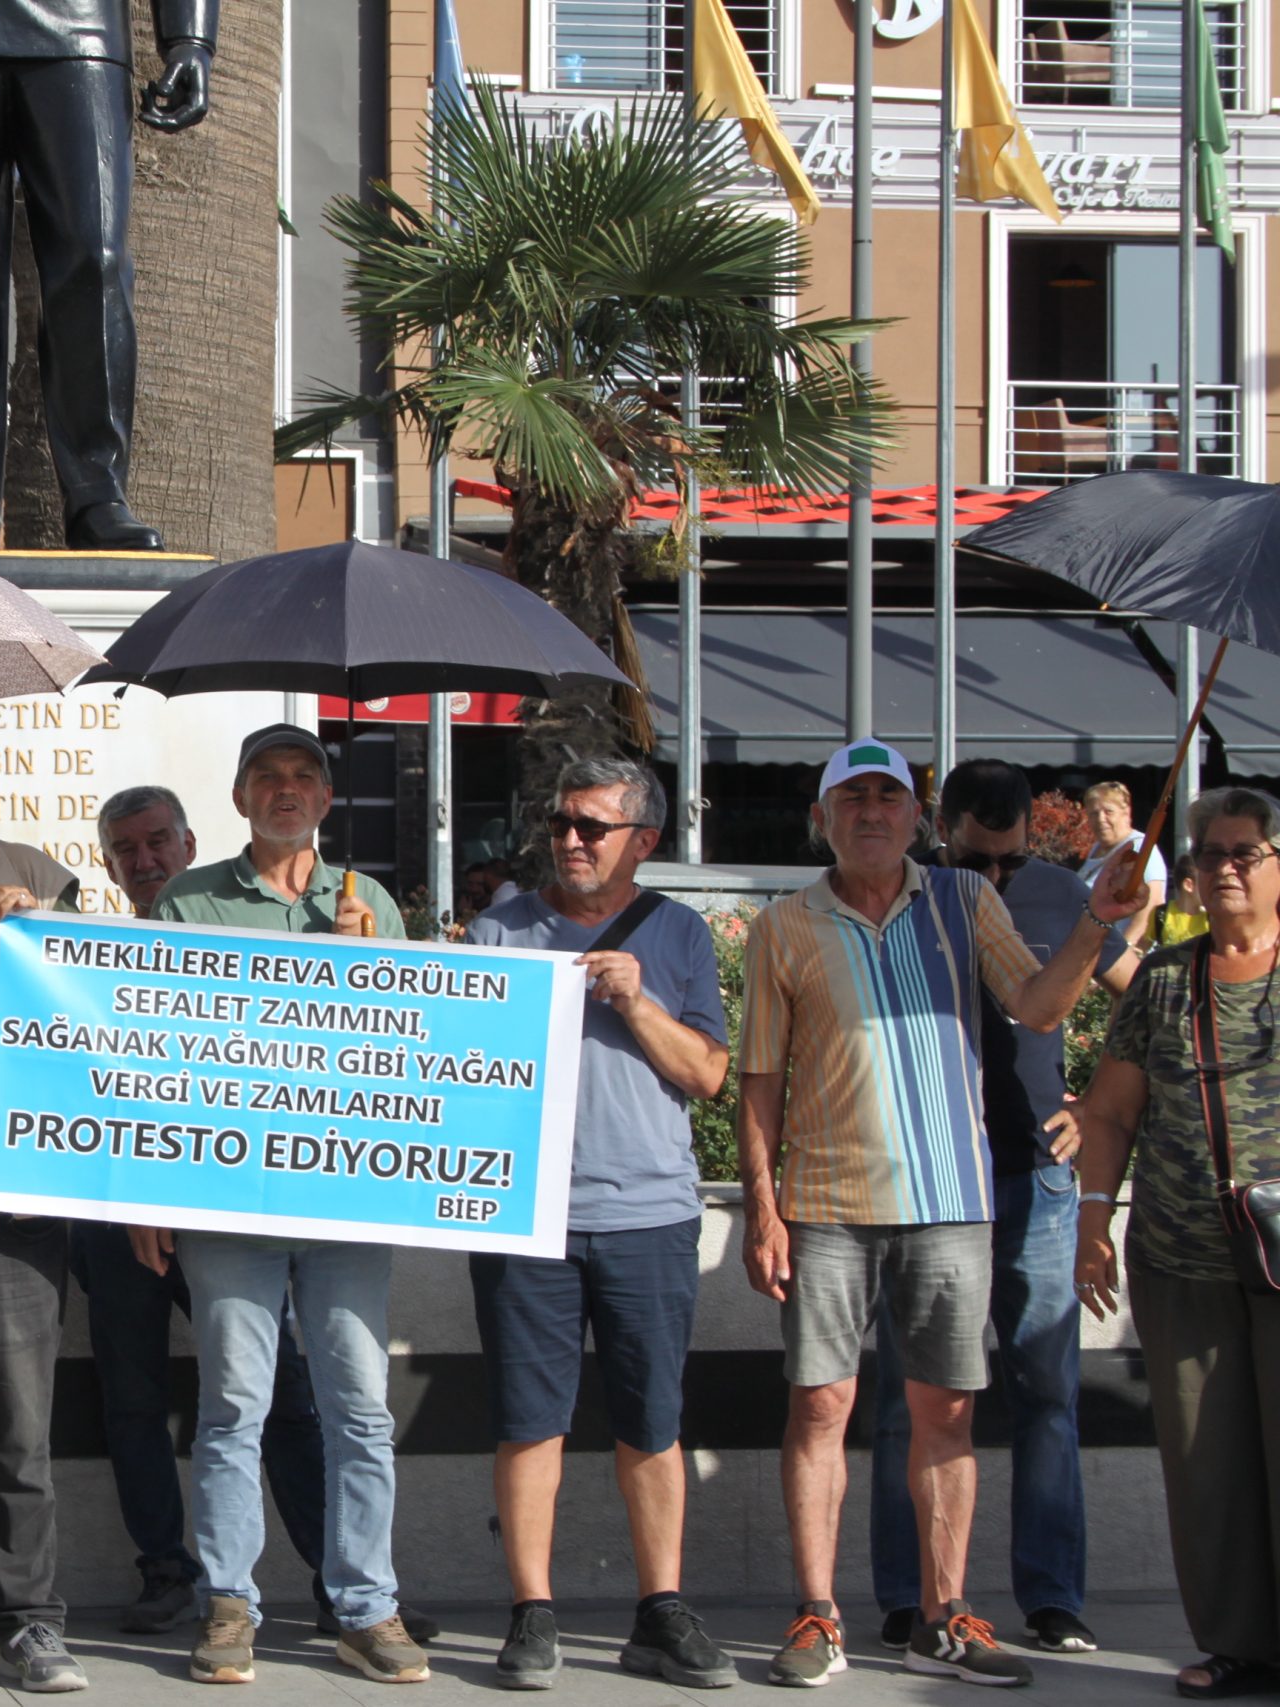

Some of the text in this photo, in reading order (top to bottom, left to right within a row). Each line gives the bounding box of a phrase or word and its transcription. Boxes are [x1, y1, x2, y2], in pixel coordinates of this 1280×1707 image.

[80, 703, 120, 729] DE
[53, 749, 94, 775] DE
[58, 795, 99, 821] DE
[43, 937, 508, 1000] EMEKLİLERE REVA GÖRÜLEN
[114, 987, 427, 1041] SEFALET ZAMMINI,
[1, 1018, 534, 1088] SAĞANAK YAĞMUR GİBİ YAĞAN
[91, 1069, 441, 1125] VERGİ VE ZAMLARINI
[7, 1112, 513, 1188] PROTESTO EDİYORUZ!
[437, 1195, 498, 1222] BİEP
